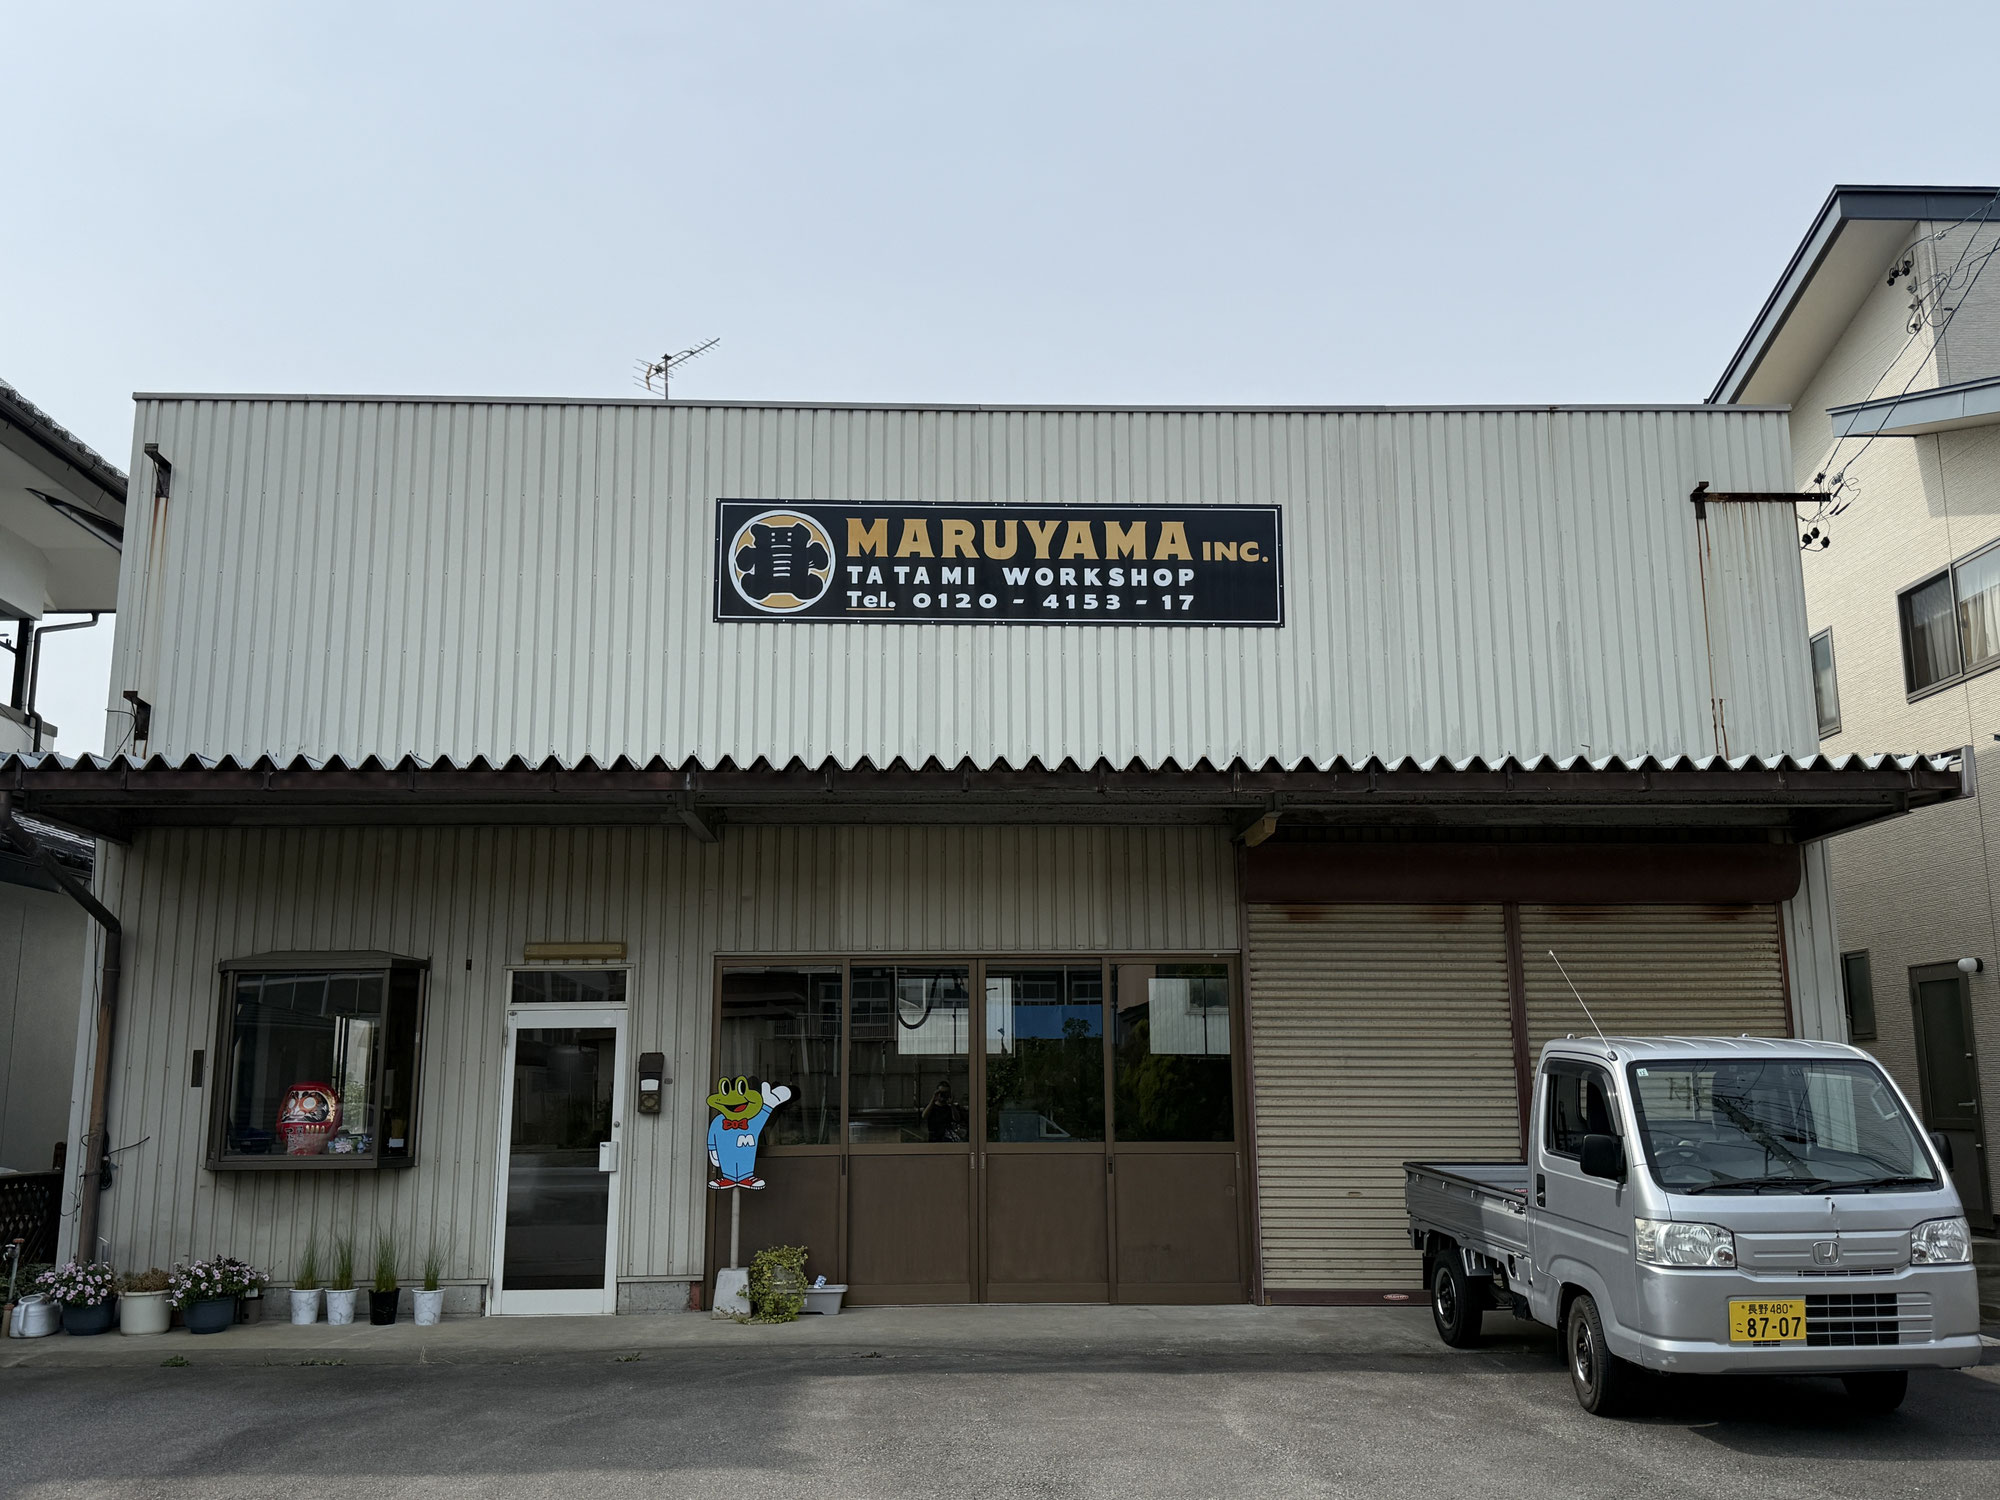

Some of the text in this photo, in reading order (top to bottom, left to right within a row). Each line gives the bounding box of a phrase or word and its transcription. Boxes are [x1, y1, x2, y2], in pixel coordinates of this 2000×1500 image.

[846, 517, 1269, 563] MARUYAMA INC.
[1001, 567, 1195, 587] WORKSHOP
[846, 590, 897, 608] Tel.
[736, 1134, 756, 1148] M
[1747, 1317, 1801, 1338] 87-07
